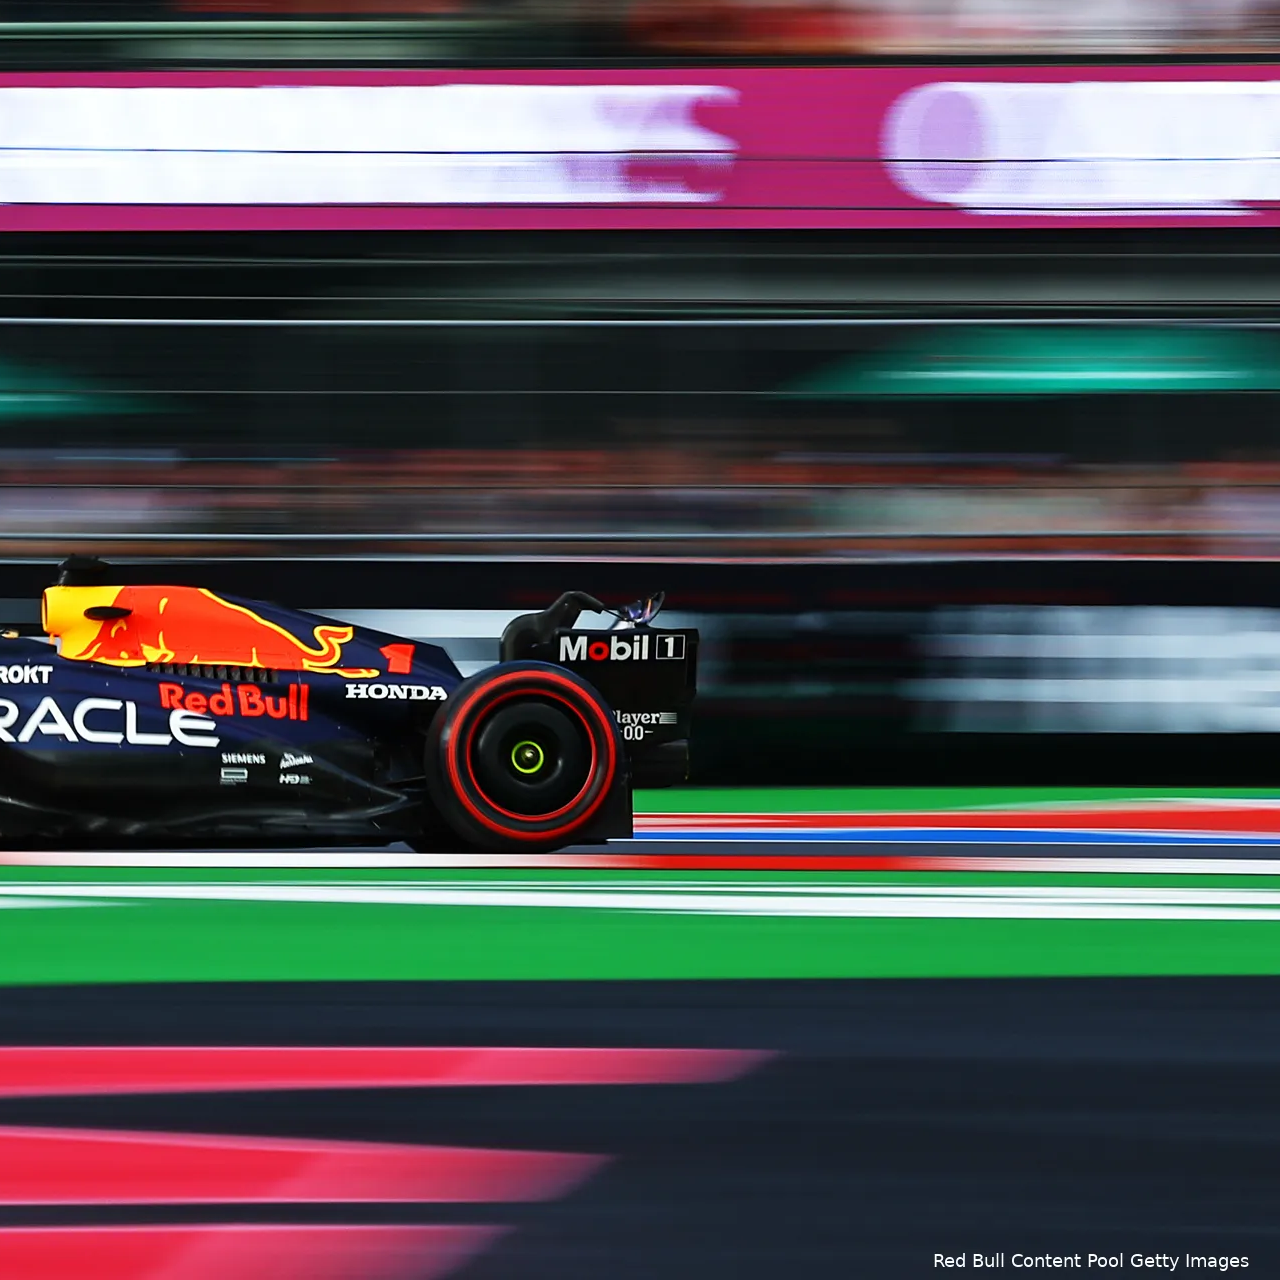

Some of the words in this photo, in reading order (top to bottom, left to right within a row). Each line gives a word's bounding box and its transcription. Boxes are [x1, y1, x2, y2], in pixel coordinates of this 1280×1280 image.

[378, 643, 416, 674] 1
[559, 635, 649, 661] Mobil
[159, 682, 234, 716] Red
[238, 684, 309, 721] Bull
[345, 683, 448, 701] HONDA
[612, 709, 660, 727] layer
[221, 753, 266, 765] SIEMENS
